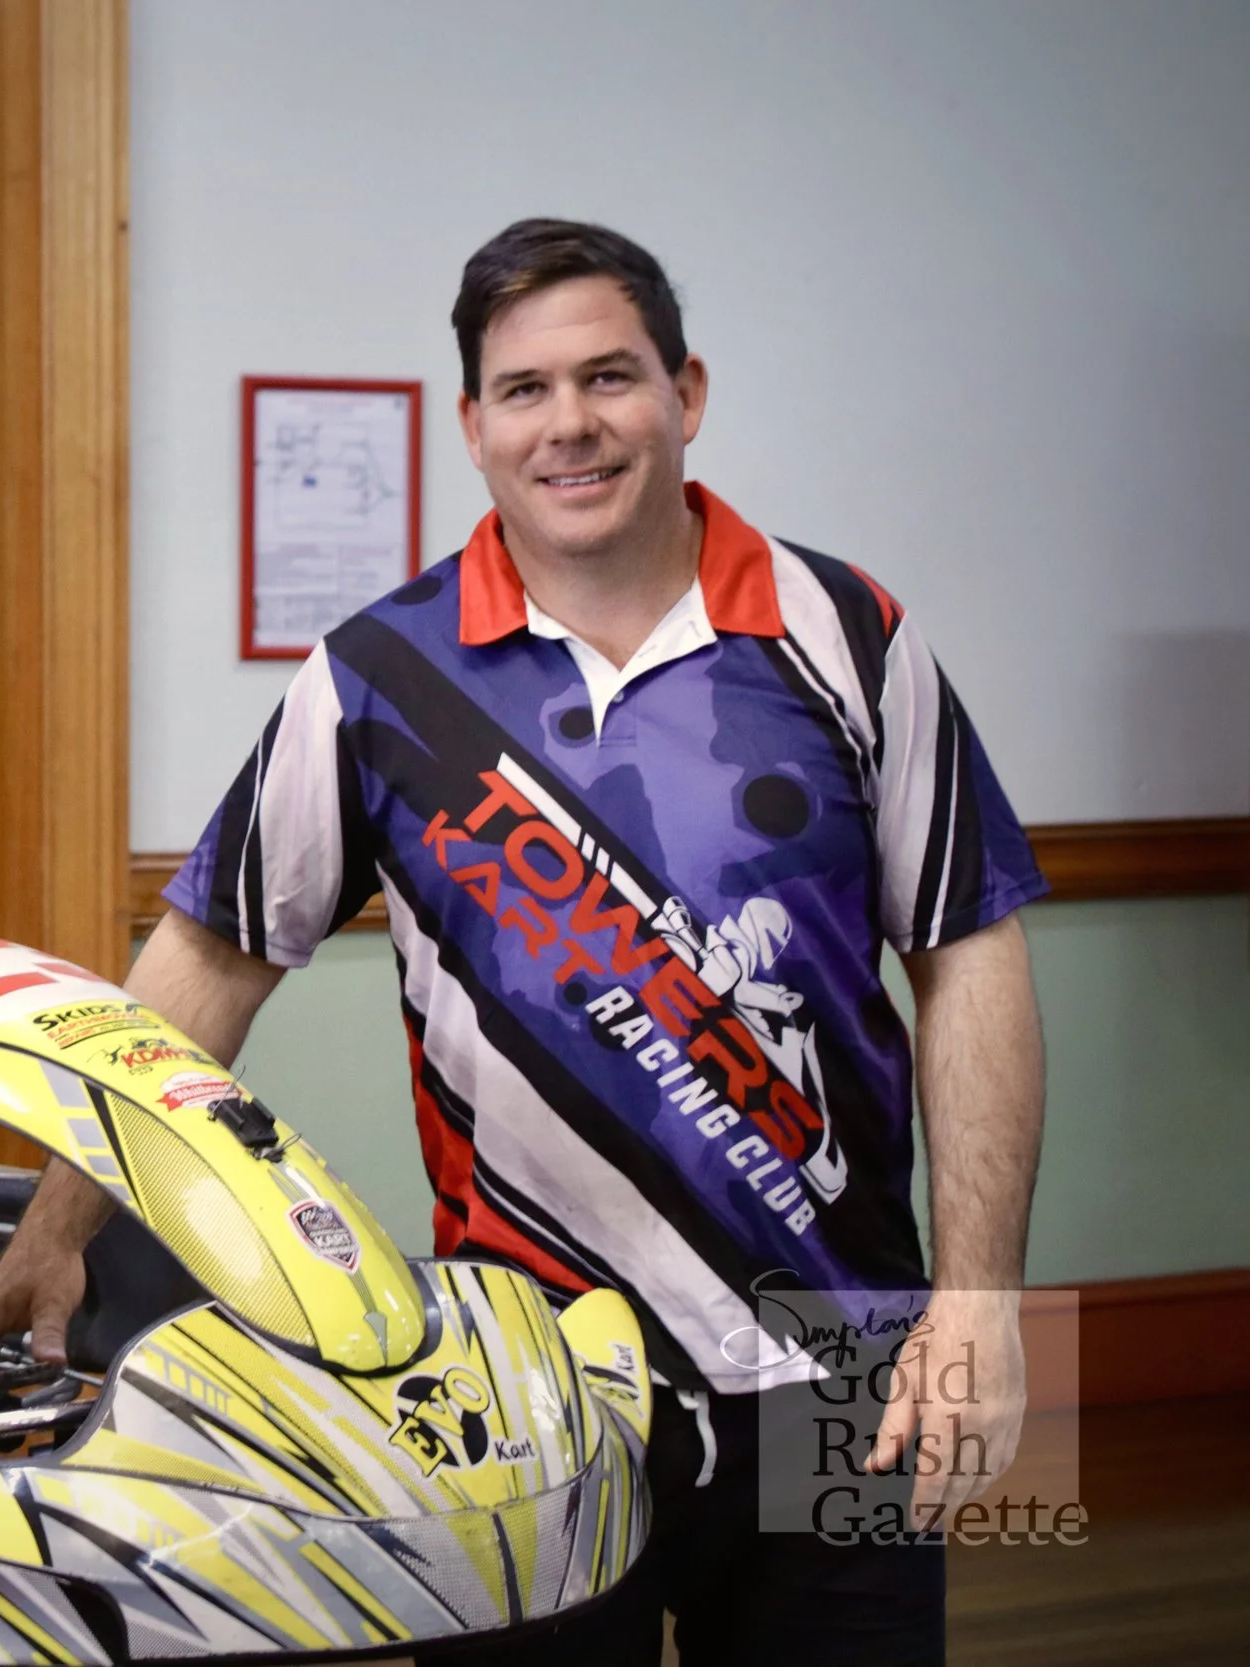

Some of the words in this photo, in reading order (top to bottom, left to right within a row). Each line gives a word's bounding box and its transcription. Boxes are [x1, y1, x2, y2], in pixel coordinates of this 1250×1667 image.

[422, 810, 606, 985] KART
[464, 769, 825, 1161] TOWERS
[585, 985, 741, 1140] RACING
[725, 1134, 817, 1237] CLUB
[388, 1367, 492, 1478] EVO
[494, 1440, 536, 1462] Kart
